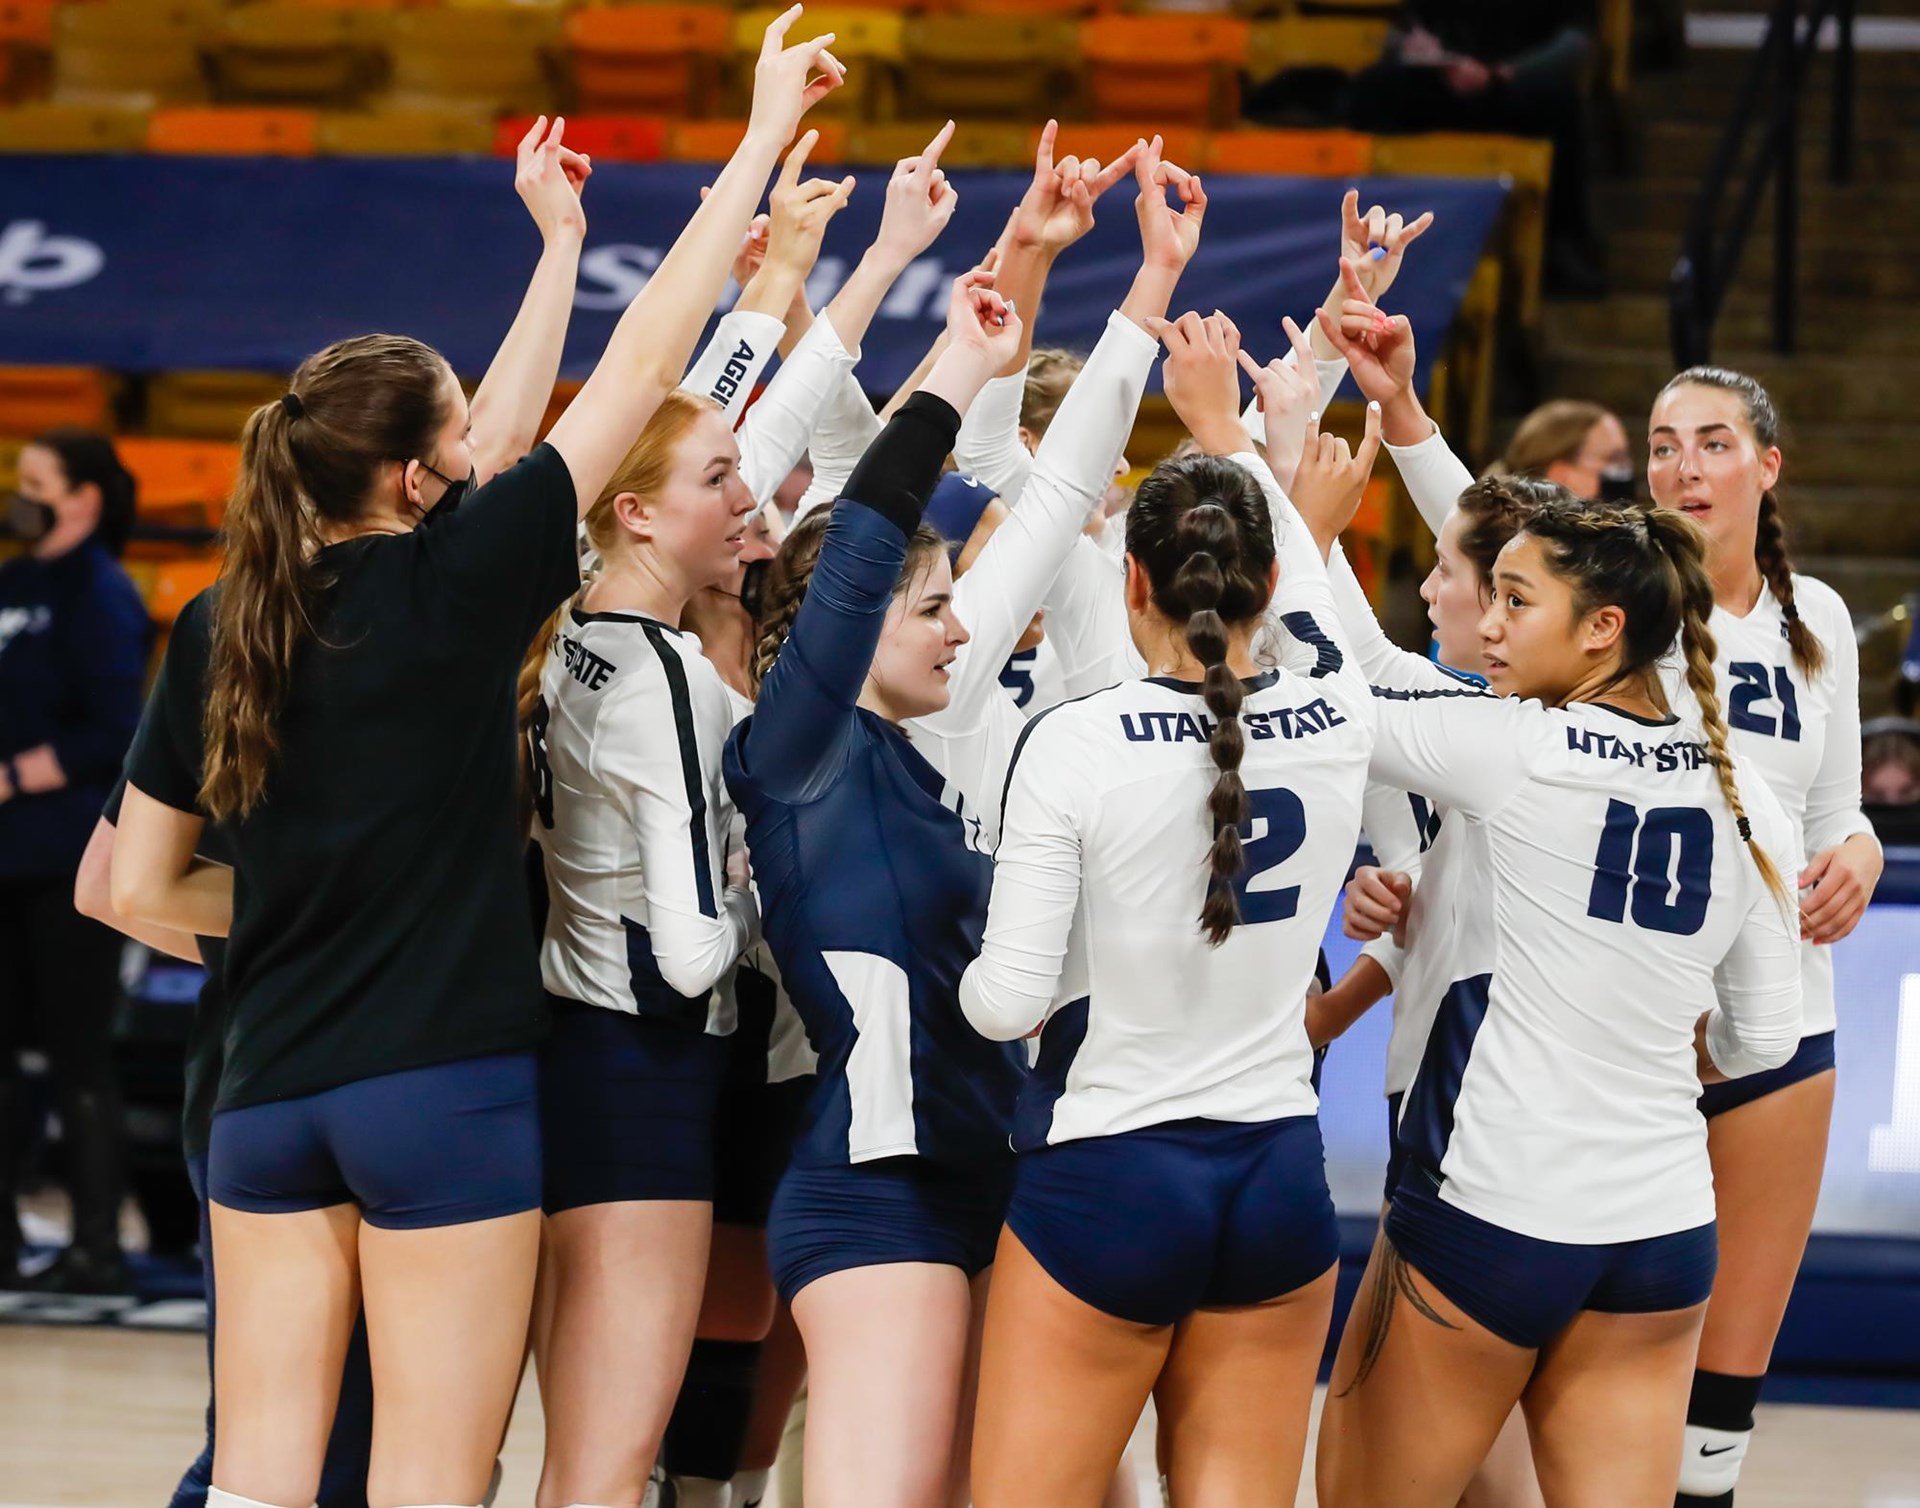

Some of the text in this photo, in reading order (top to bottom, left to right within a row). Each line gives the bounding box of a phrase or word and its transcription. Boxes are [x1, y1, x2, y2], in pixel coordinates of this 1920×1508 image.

[711, 339, 755, 410] AGGI
[1242, 697, 1348, 741] STATE
[1728, 661, 1802, 742] 21
[1654, 740, 1722, 772] STA
[1204, 787, 1307, 926] 2
[1586, 797, 1714, 936] 10
